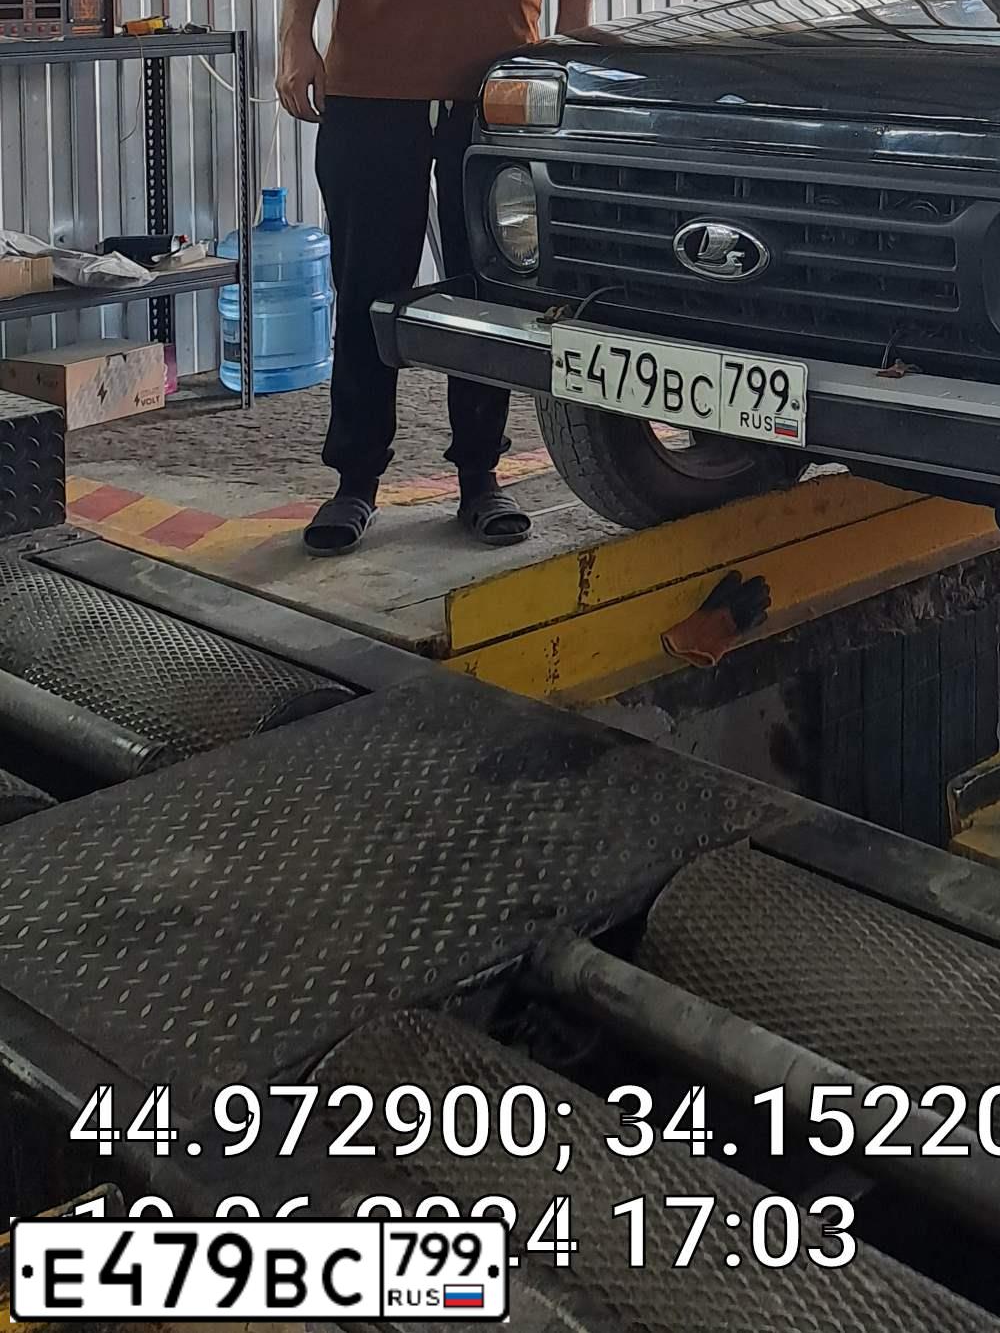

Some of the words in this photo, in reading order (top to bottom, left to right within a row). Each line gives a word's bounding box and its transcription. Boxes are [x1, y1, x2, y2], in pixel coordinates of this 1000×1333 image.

[724, 361, 790, 414] 799
[140, 395, 160, 407] VOLT
[739, 411, 773, 433] RUS
